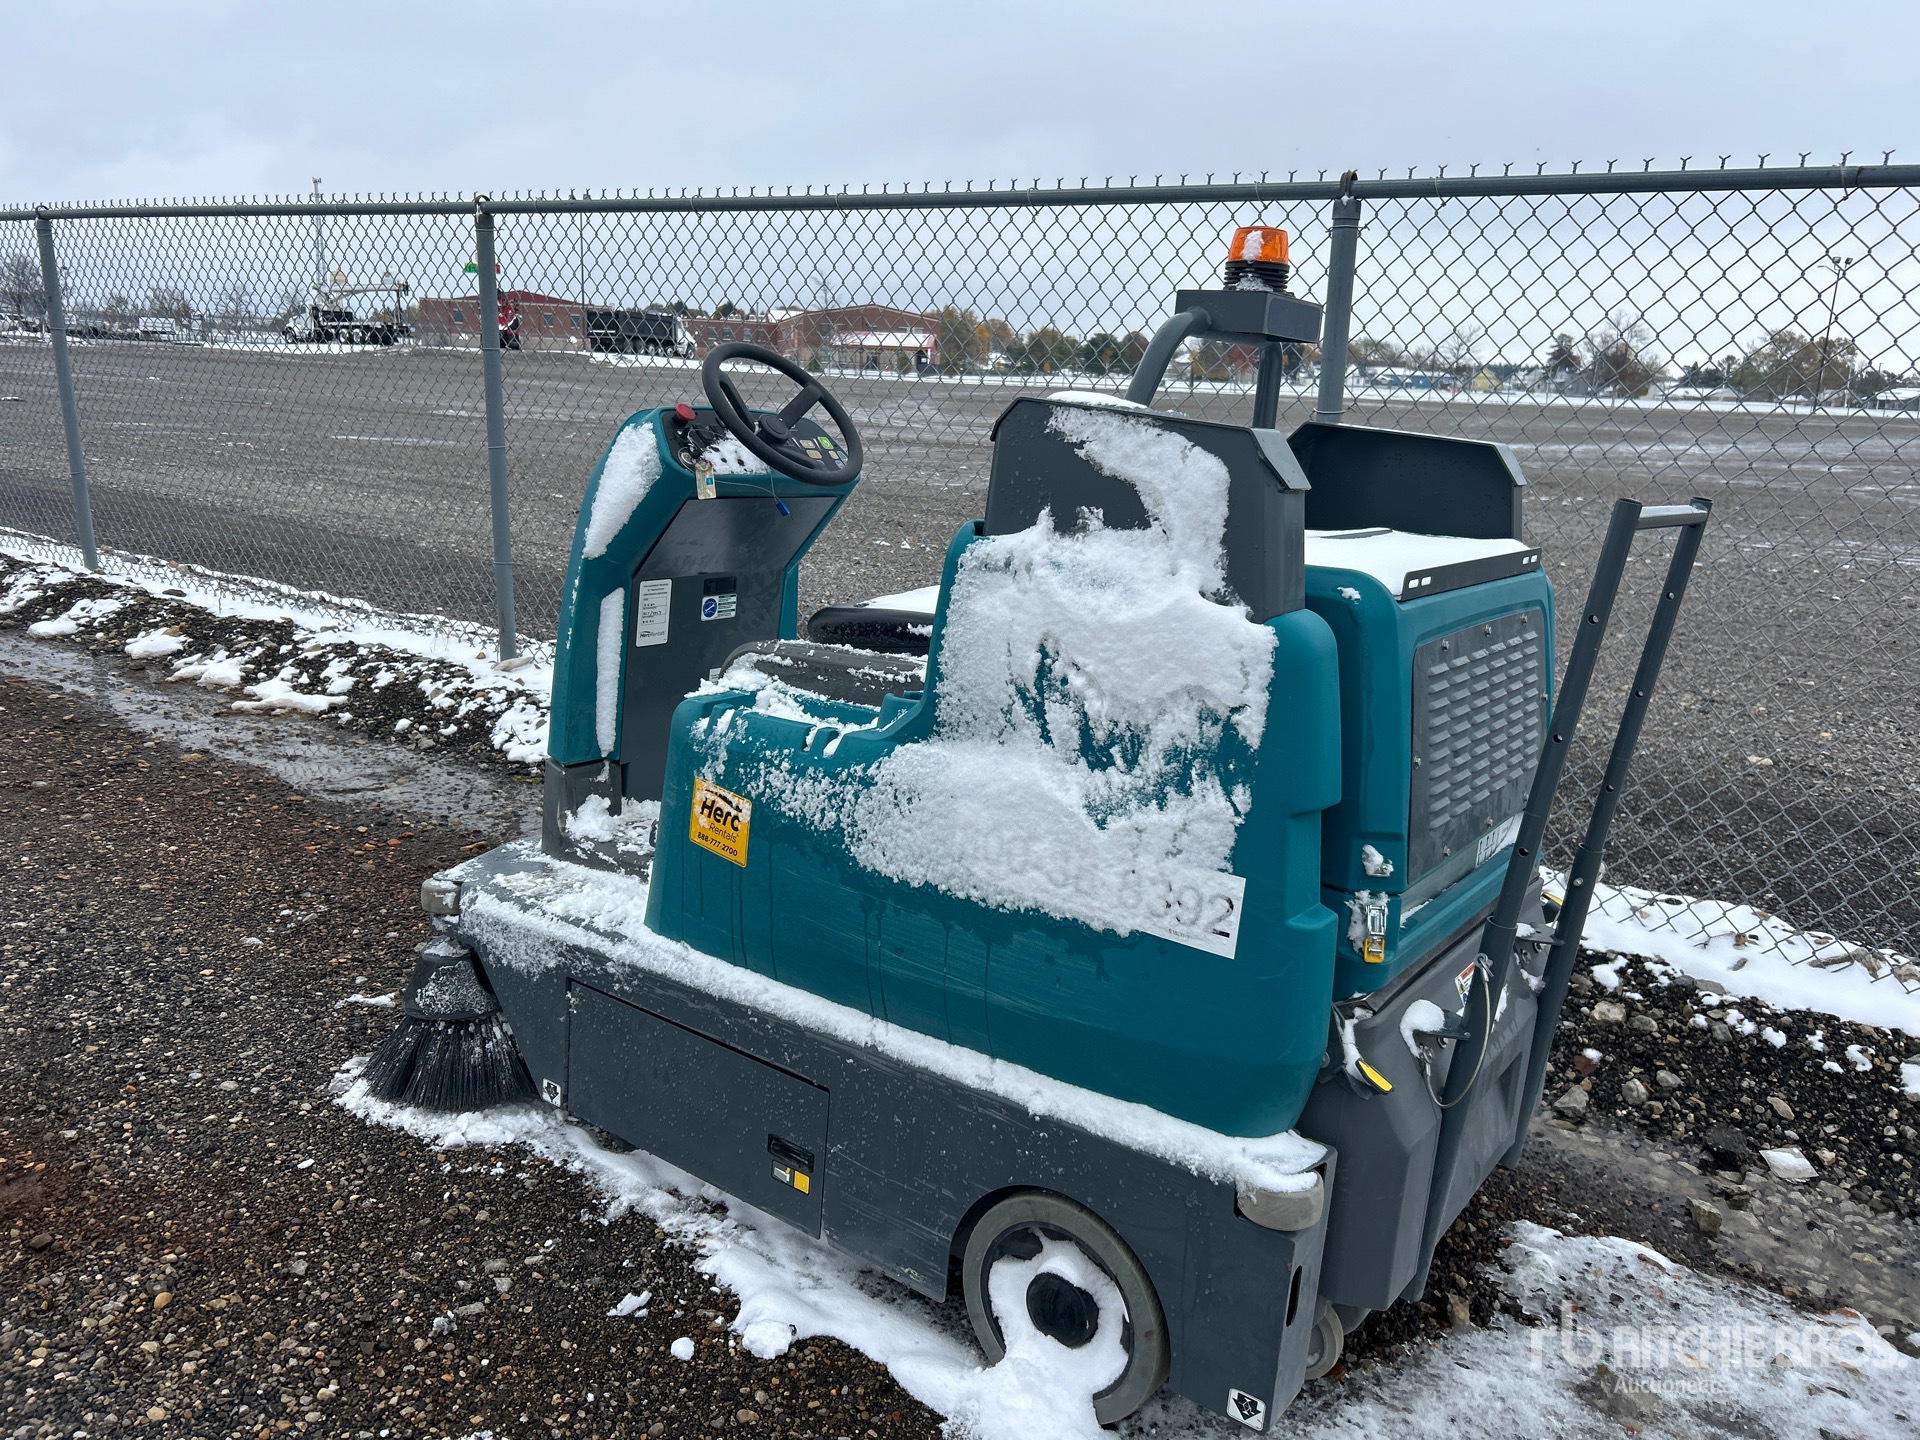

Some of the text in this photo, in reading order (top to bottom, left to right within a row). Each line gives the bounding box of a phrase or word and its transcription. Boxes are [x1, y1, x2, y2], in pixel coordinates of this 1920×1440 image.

[700, 797, 741, 832] Herc
[697, 831, 738, 857] 888-777-2700
[708, 822, 738, 844] Rentals
